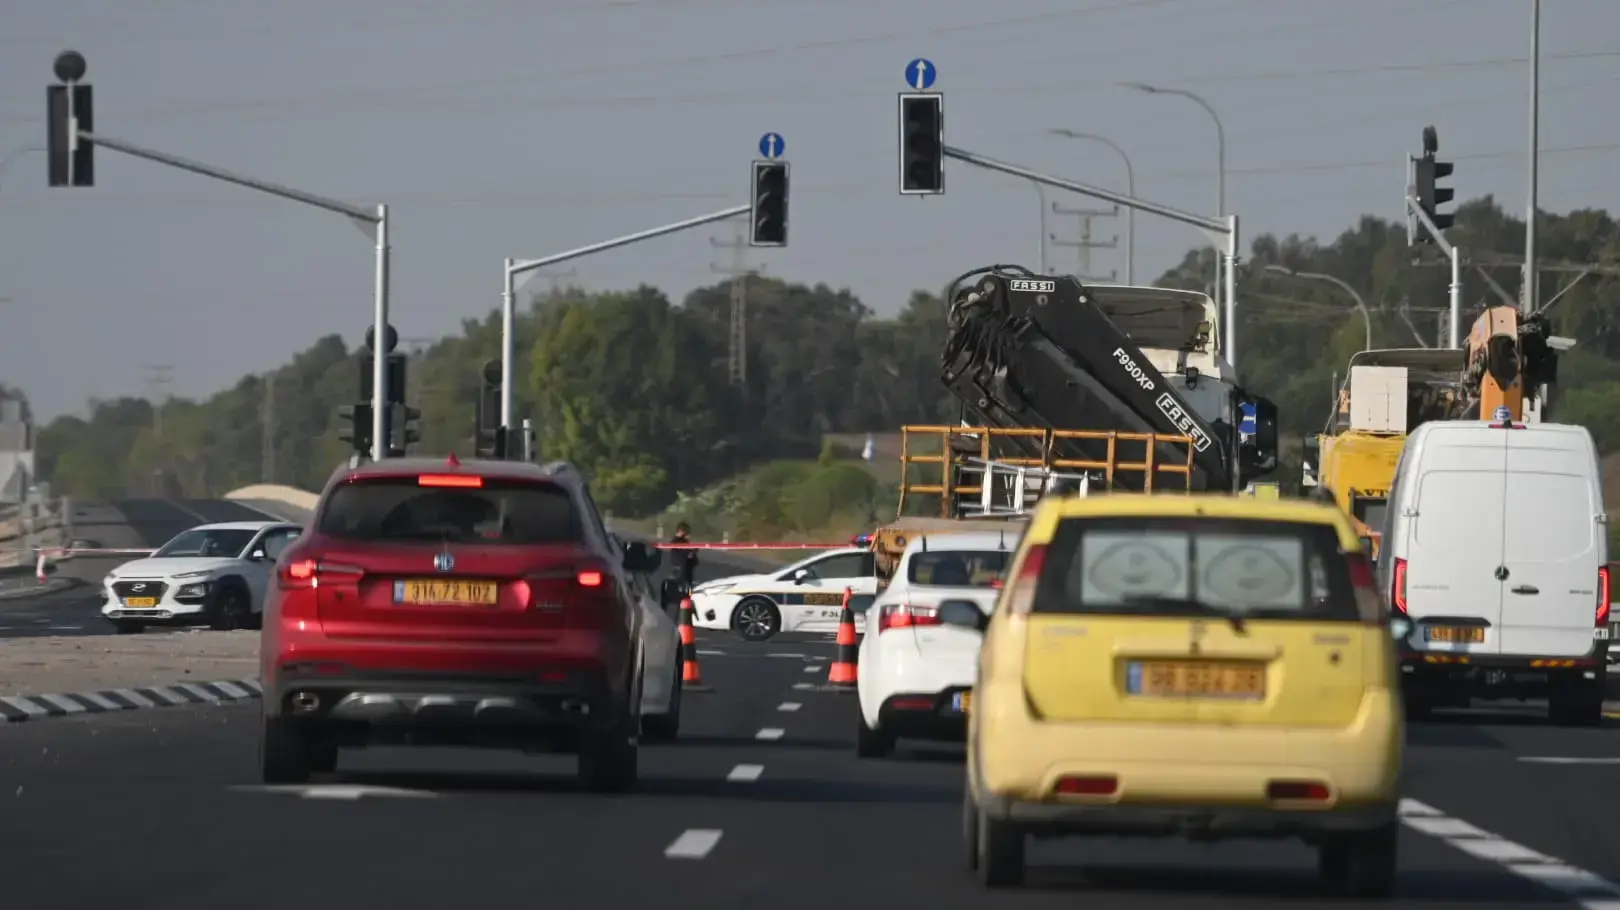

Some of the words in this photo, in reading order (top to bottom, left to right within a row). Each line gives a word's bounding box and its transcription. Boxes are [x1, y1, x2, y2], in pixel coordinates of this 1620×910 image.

[1013, 281, 1051, 290] FASSI
[1112, 347, 1155, 391] F950XP
[1160, 398, 1206, 446] FASSI
